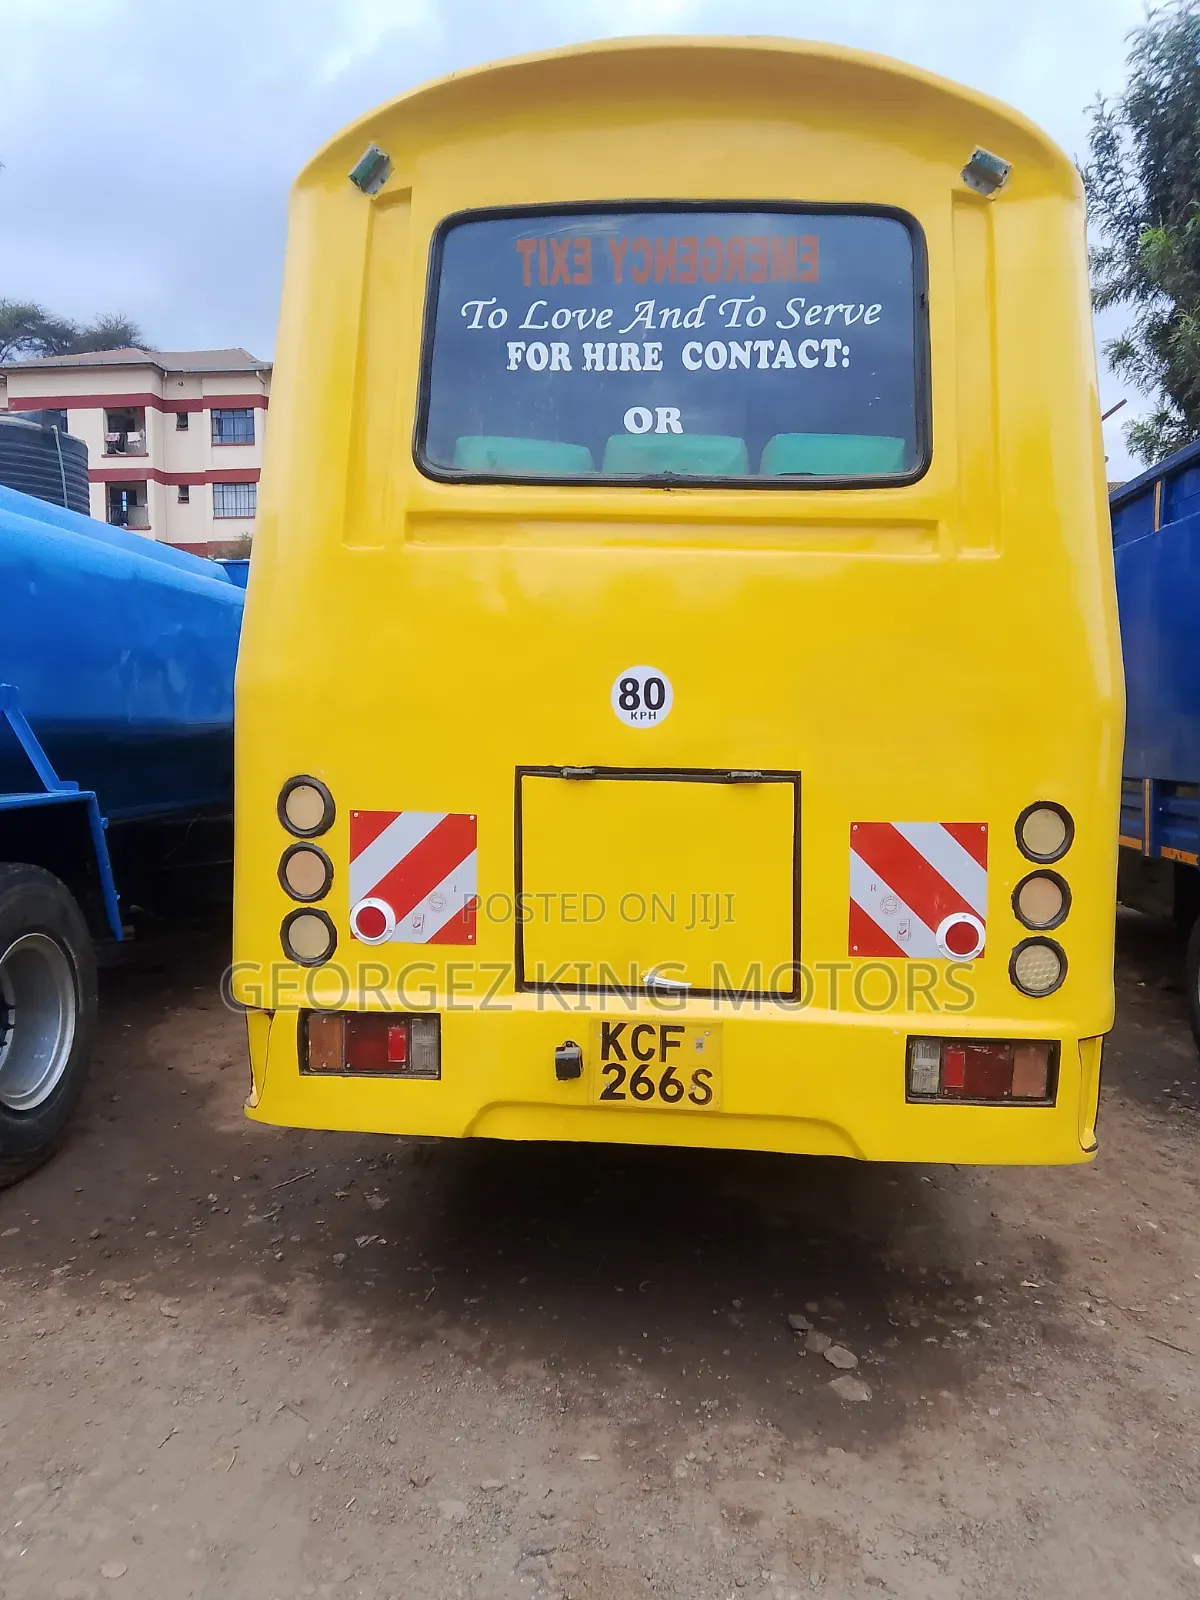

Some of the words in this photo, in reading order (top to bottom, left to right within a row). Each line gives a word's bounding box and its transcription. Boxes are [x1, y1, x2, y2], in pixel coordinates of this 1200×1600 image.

[461, 297, 508, 330] To
[518, 300, 614, 331] Love
[618, 294, 716, 334] And
[718, 295, 767, 328] To
[775, 297, 882, 330] Serve
[506, 341, 572, 371] FOR
[582, 341, 664, 371] HIRE
[681, 338, 851, 371] CONTACT:
[623, 407, 684, 435] OR
[618, 677, 666, 711] 80
[630, 711, 657, 720] KPH
[870, 884, 877, 892] R
[601, 1021, 685, 1062] KCF
[599, 1062, 713, 1105] 266S
